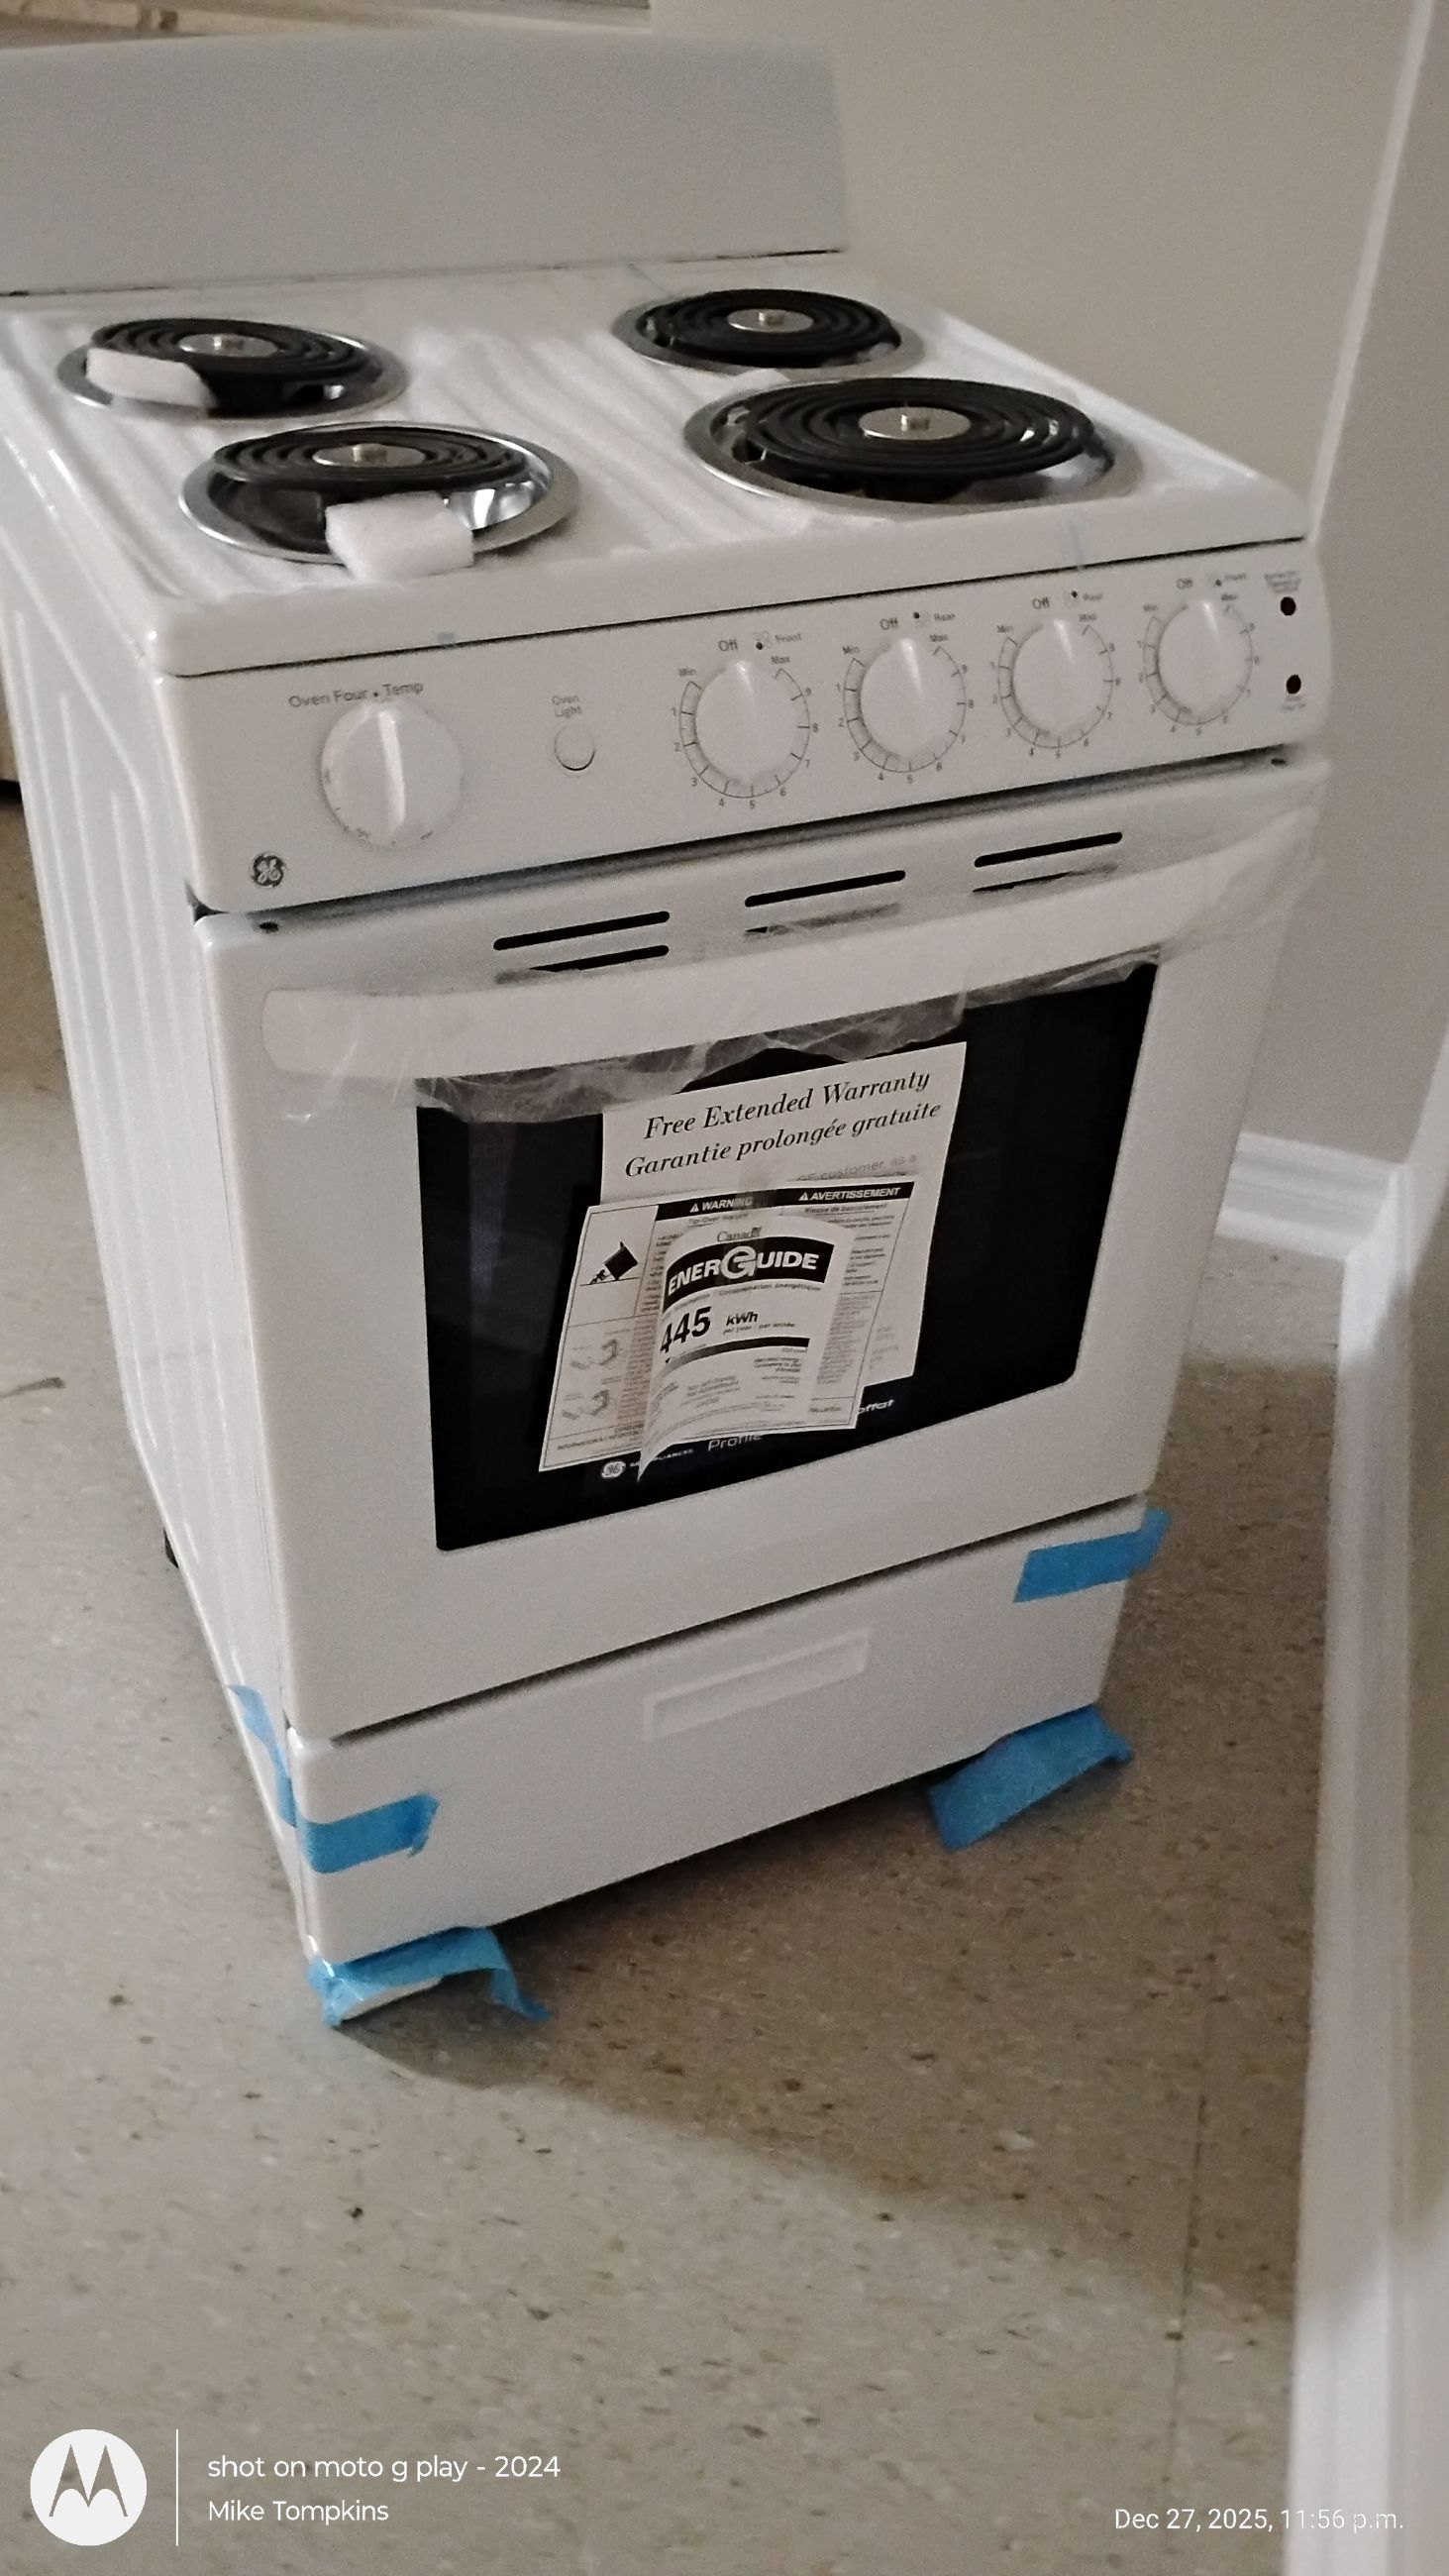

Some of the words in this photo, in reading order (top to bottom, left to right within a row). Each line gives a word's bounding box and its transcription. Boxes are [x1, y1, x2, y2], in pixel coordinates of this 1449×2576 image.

[1032, 596, 1050, 610] Off
[880, 617, 898, 630] Off
[718, 638, 739, 651] Off
[288, 695, 330, 707] Oven
[382, 684, 424, 697] Temp
[551, 695, 579, 706] Oven
[644, 1116, 695, 1139] Free
[703, 1089, 813, 1128] Extended
[823, 1070, 930, 1106] Warranty
[625, 1141, 732, 1177] Garantie
[736, 1118, 847, 1161] prolongée
[852, 1102, 943, 1137] gratuite
[810, 1187, 901, 1201] AVERTISSEMENT
[701, 1197, 754, 1211] WARNING
[726, 1311, 760, 1327] kWh
